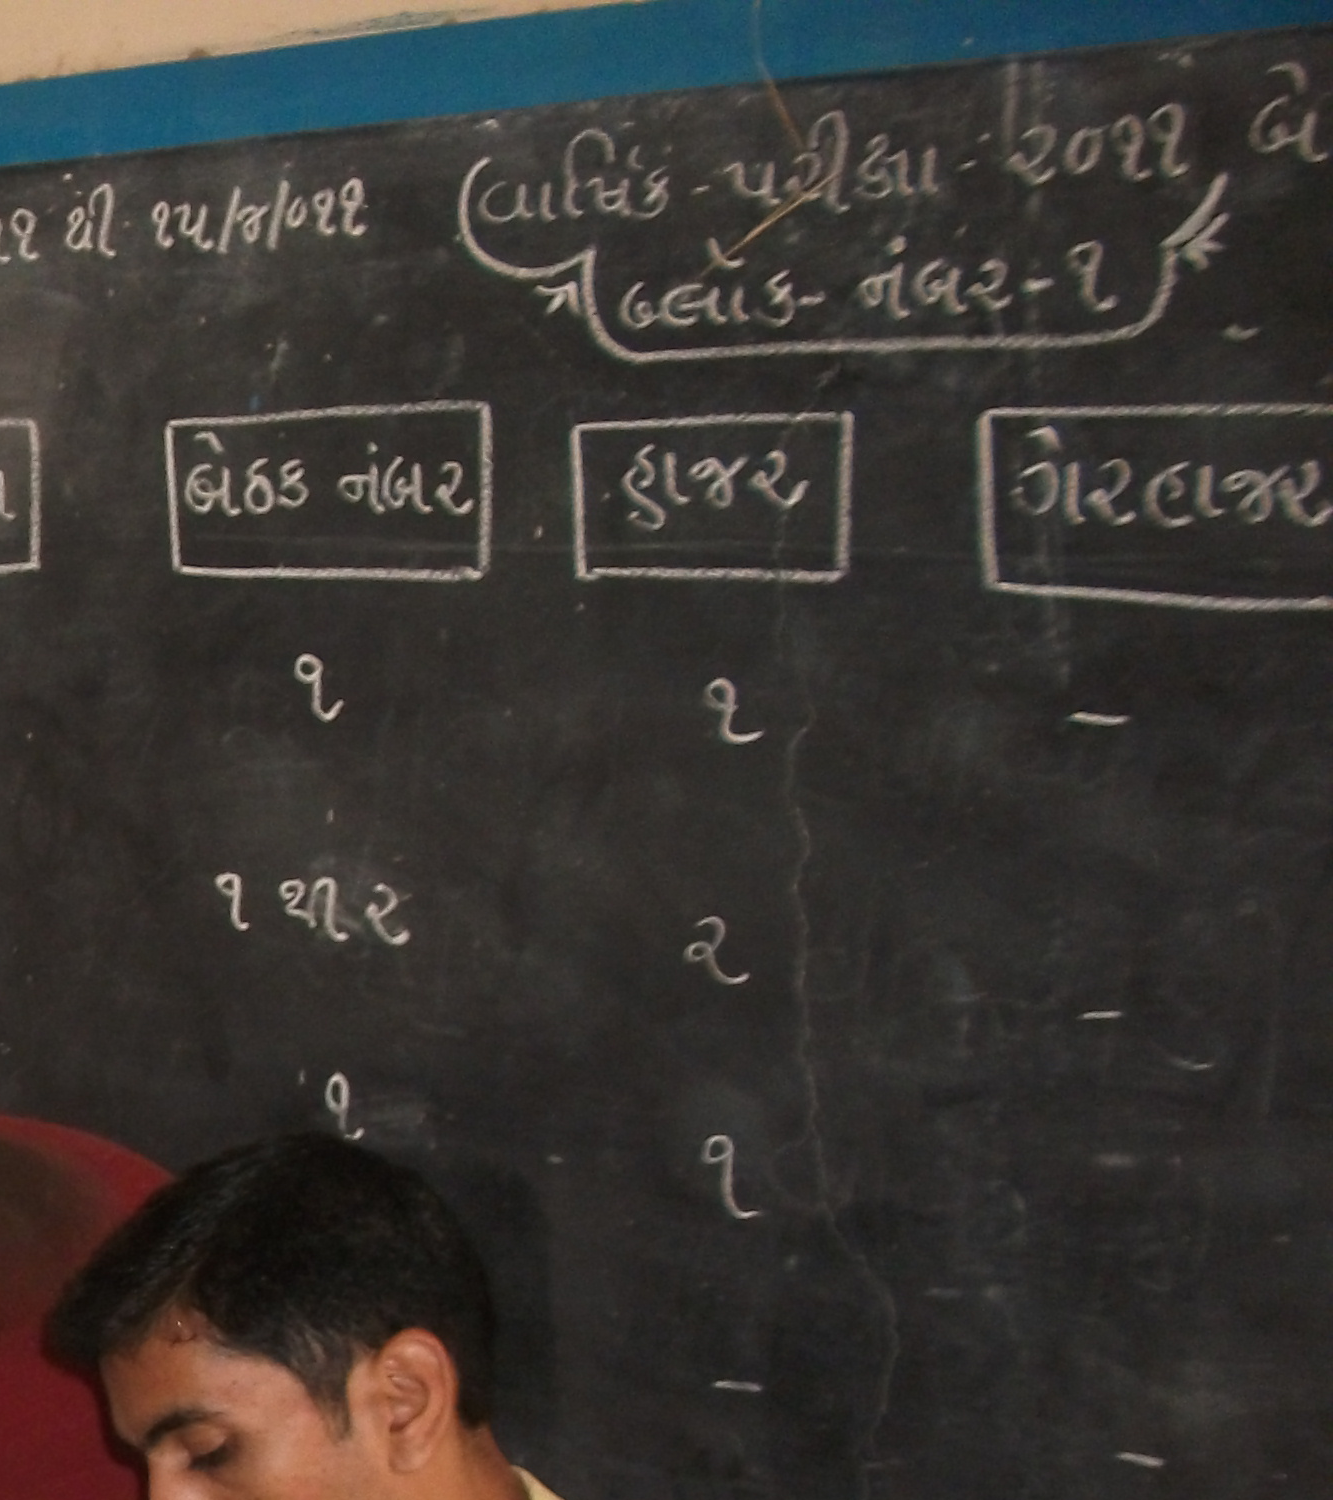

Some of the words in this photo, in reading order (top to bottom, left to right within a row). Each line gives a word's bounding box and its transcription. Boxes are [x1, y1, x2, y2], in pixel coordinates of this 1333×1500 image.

[65, 182, 117, 258] થી
[337, 443, 474, 517] નંબર
[294, 652, 343, 722] ૧
